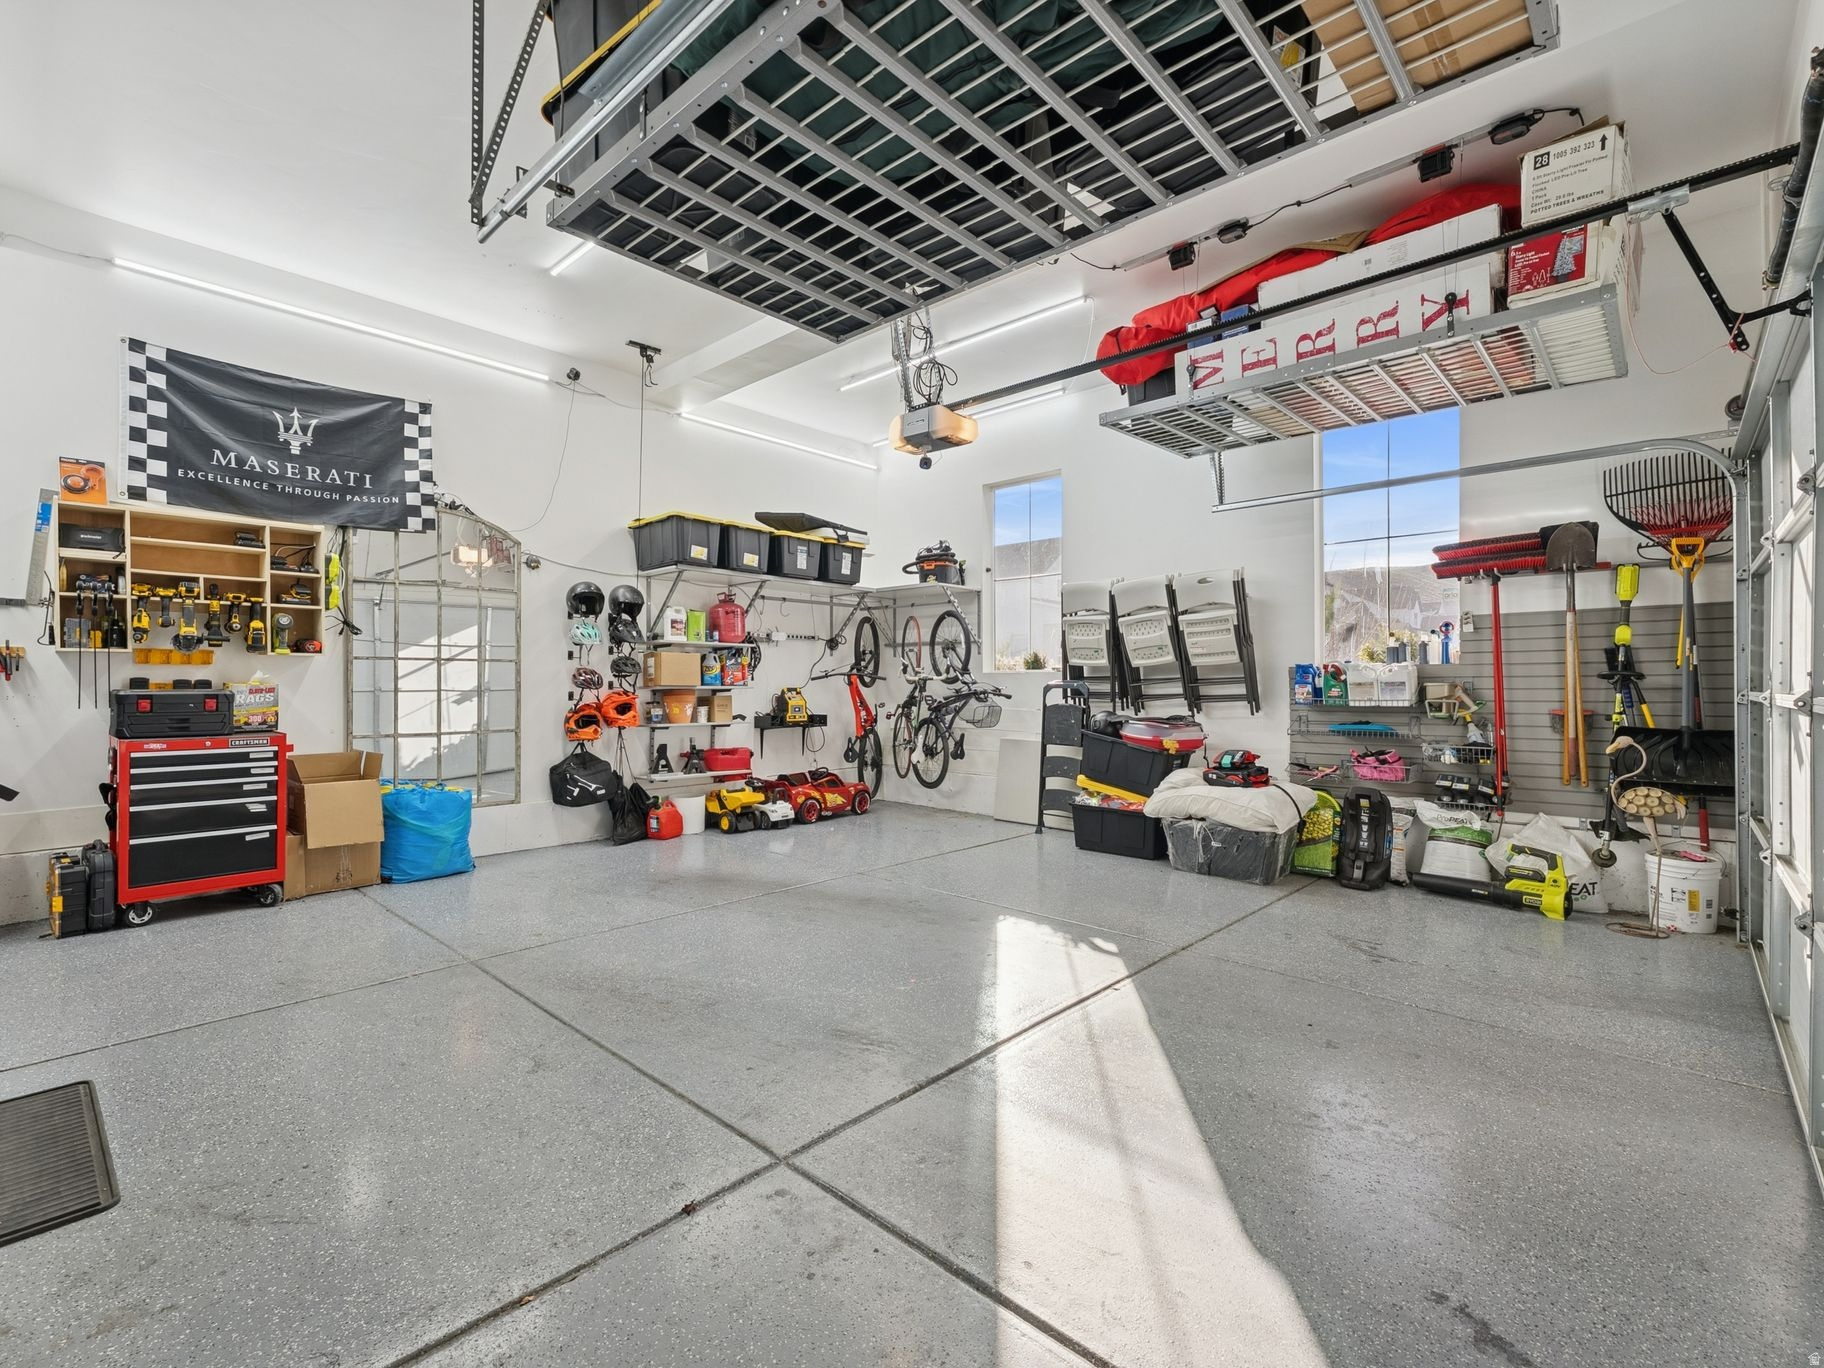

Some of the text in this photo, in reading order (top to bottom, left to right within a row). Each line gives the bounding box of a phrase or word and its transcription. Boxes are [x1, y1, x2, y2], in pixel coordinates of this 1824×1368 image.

[1535, 140, 1595, 168] 28 1005 392 323
[1530, 204, 1551, 214] POTTED
[1576, 190, 1604, 201] WREATHS
[210, 449, 373, 489] MASERATI
[178, 469, 400, 504] EXCELLENCE THROUGH PASSION
[236, 692, 274, 704] RAGS
